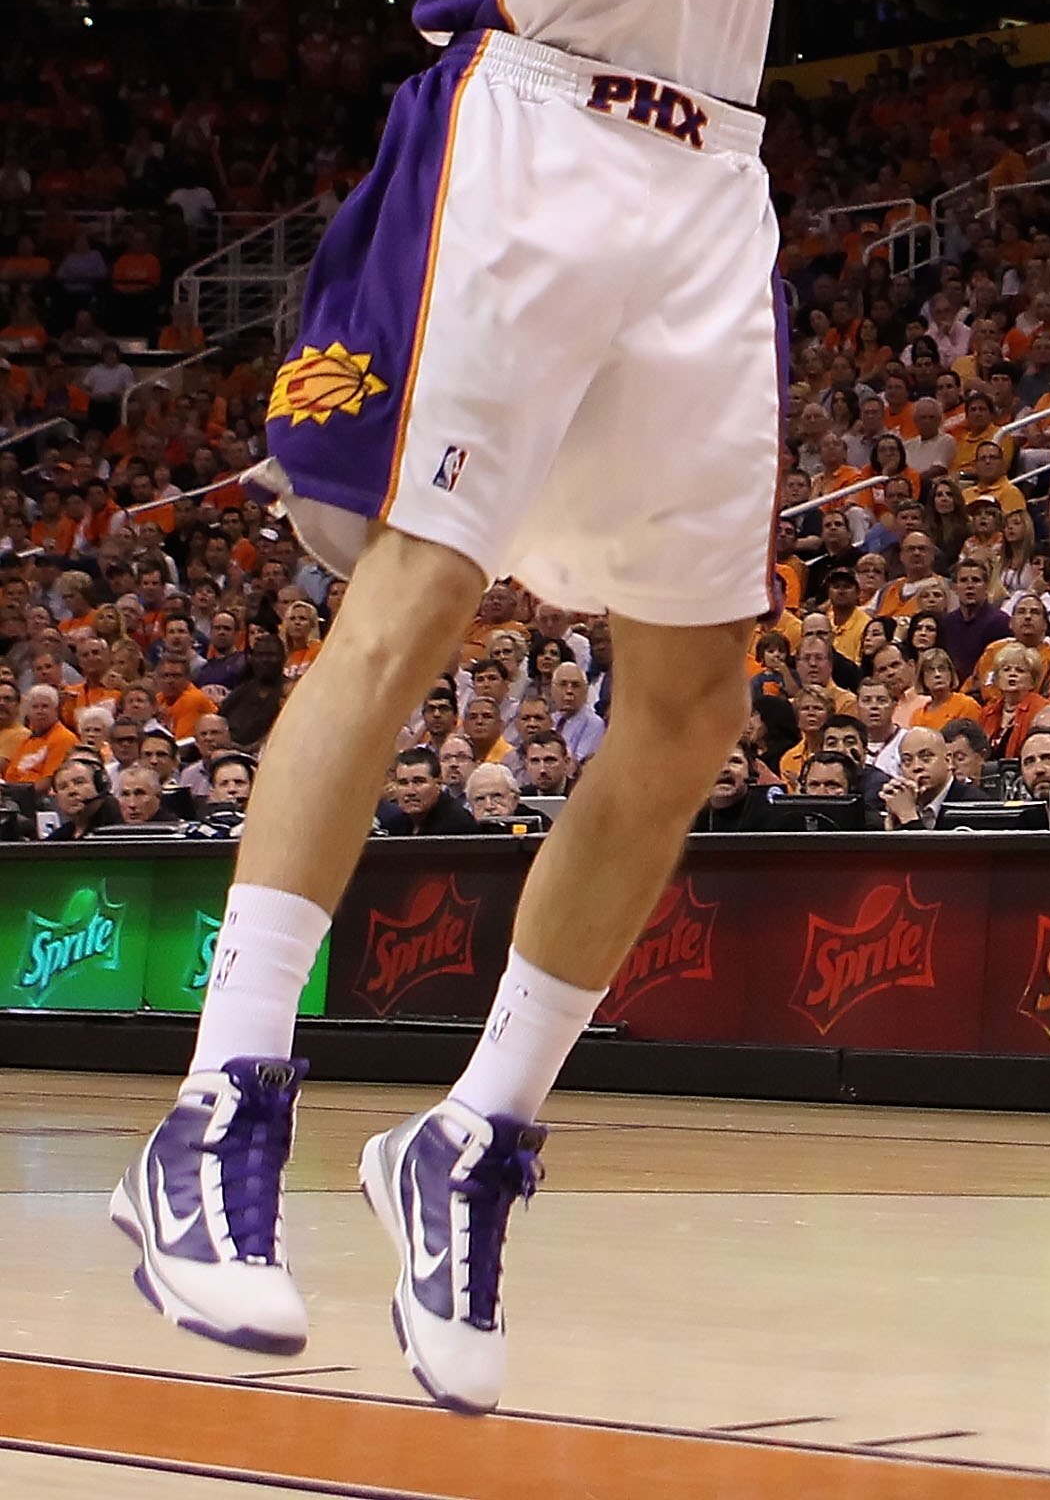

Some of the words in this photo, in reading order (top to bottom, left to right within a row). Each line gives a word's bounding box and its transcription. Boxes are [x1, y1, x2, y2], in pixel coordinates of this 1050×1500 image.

[586, 75, 710, 150] PHX
[20, 909, 115, 998] Sprite
[365, 908, 467, 994] Sprite
[612, 910, 703, 1001] prite
[807, 910, 925, 1012] Sprite
